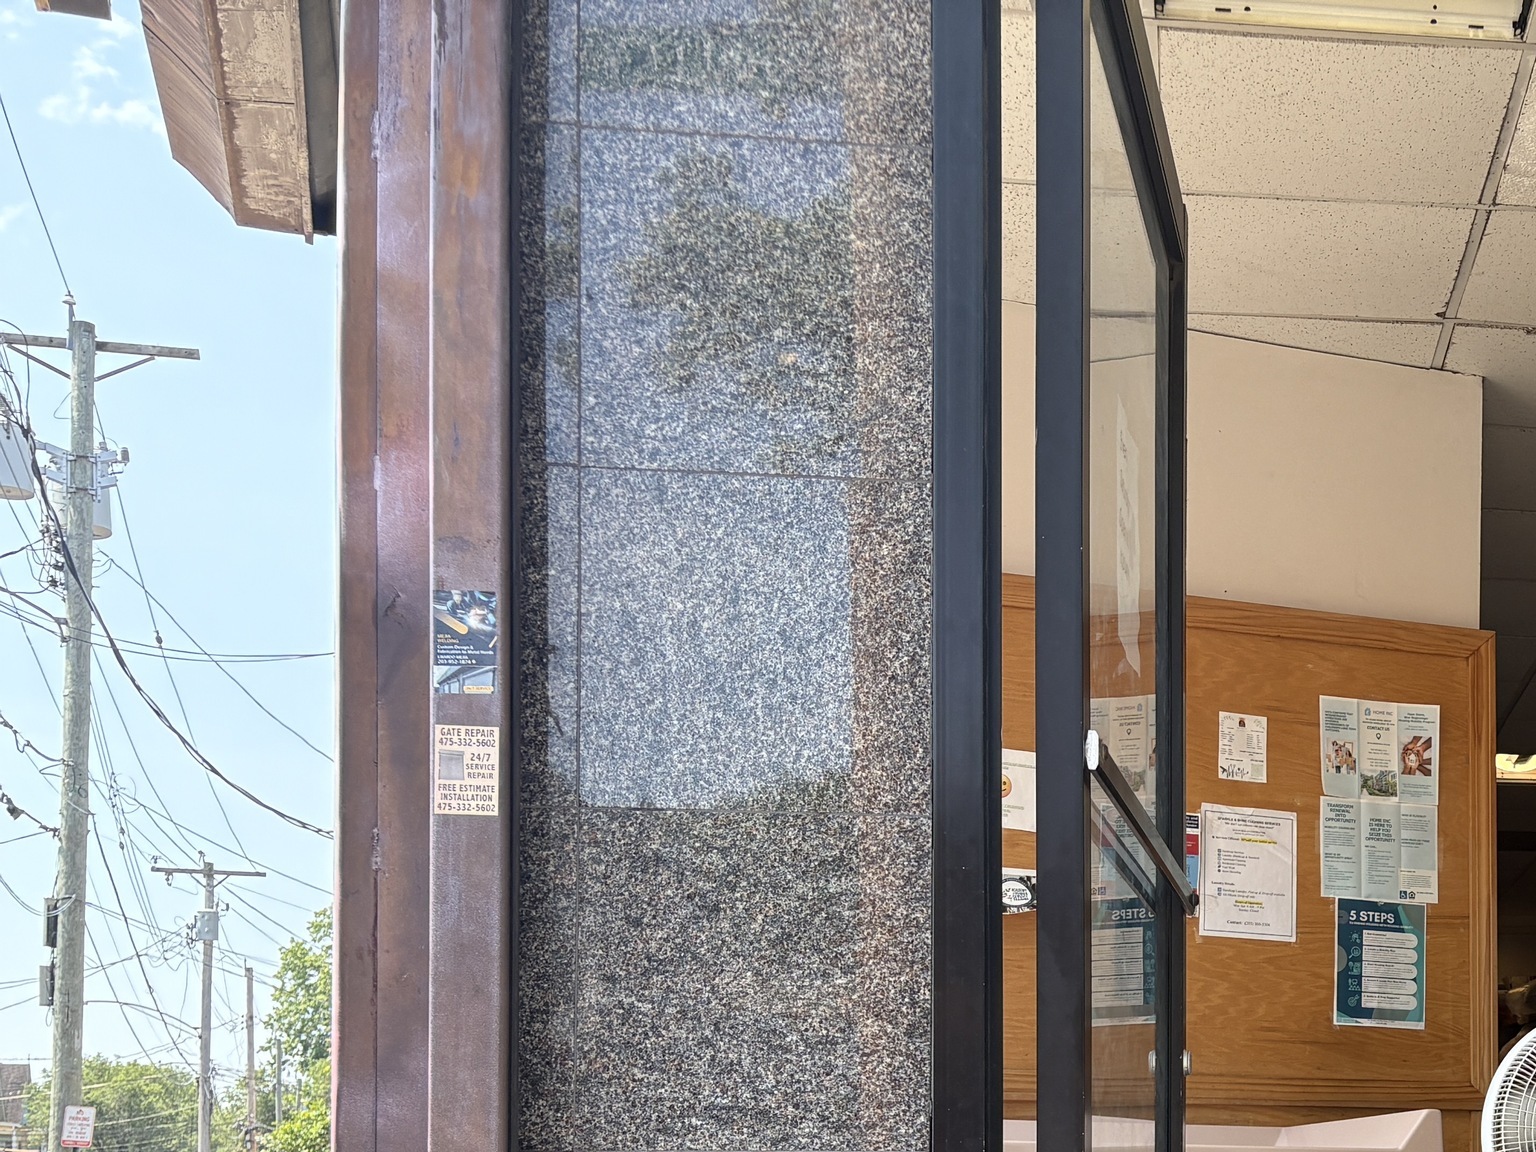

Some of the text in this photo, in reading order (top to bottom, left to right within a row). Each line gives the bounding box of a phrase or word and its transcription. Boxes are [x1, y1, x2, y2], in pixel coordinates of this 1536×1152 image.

[440, 727, 495, 738] GATE REPAIR
[438, 737, 496, 748] 475-332-5602
[470, 752, 491, 762] 24/7
[465, 763, 496, 771] SERVICE
[467, 771, 494, 779] REPAIR
[438, 783, 496, 793] FREE ESTIMATE
[440, 792, 493, 802] INSTALLATION
[437, 802, 496, 812] 475-332-5602
[1349, 910, 1395, 924] 5 STEPS
